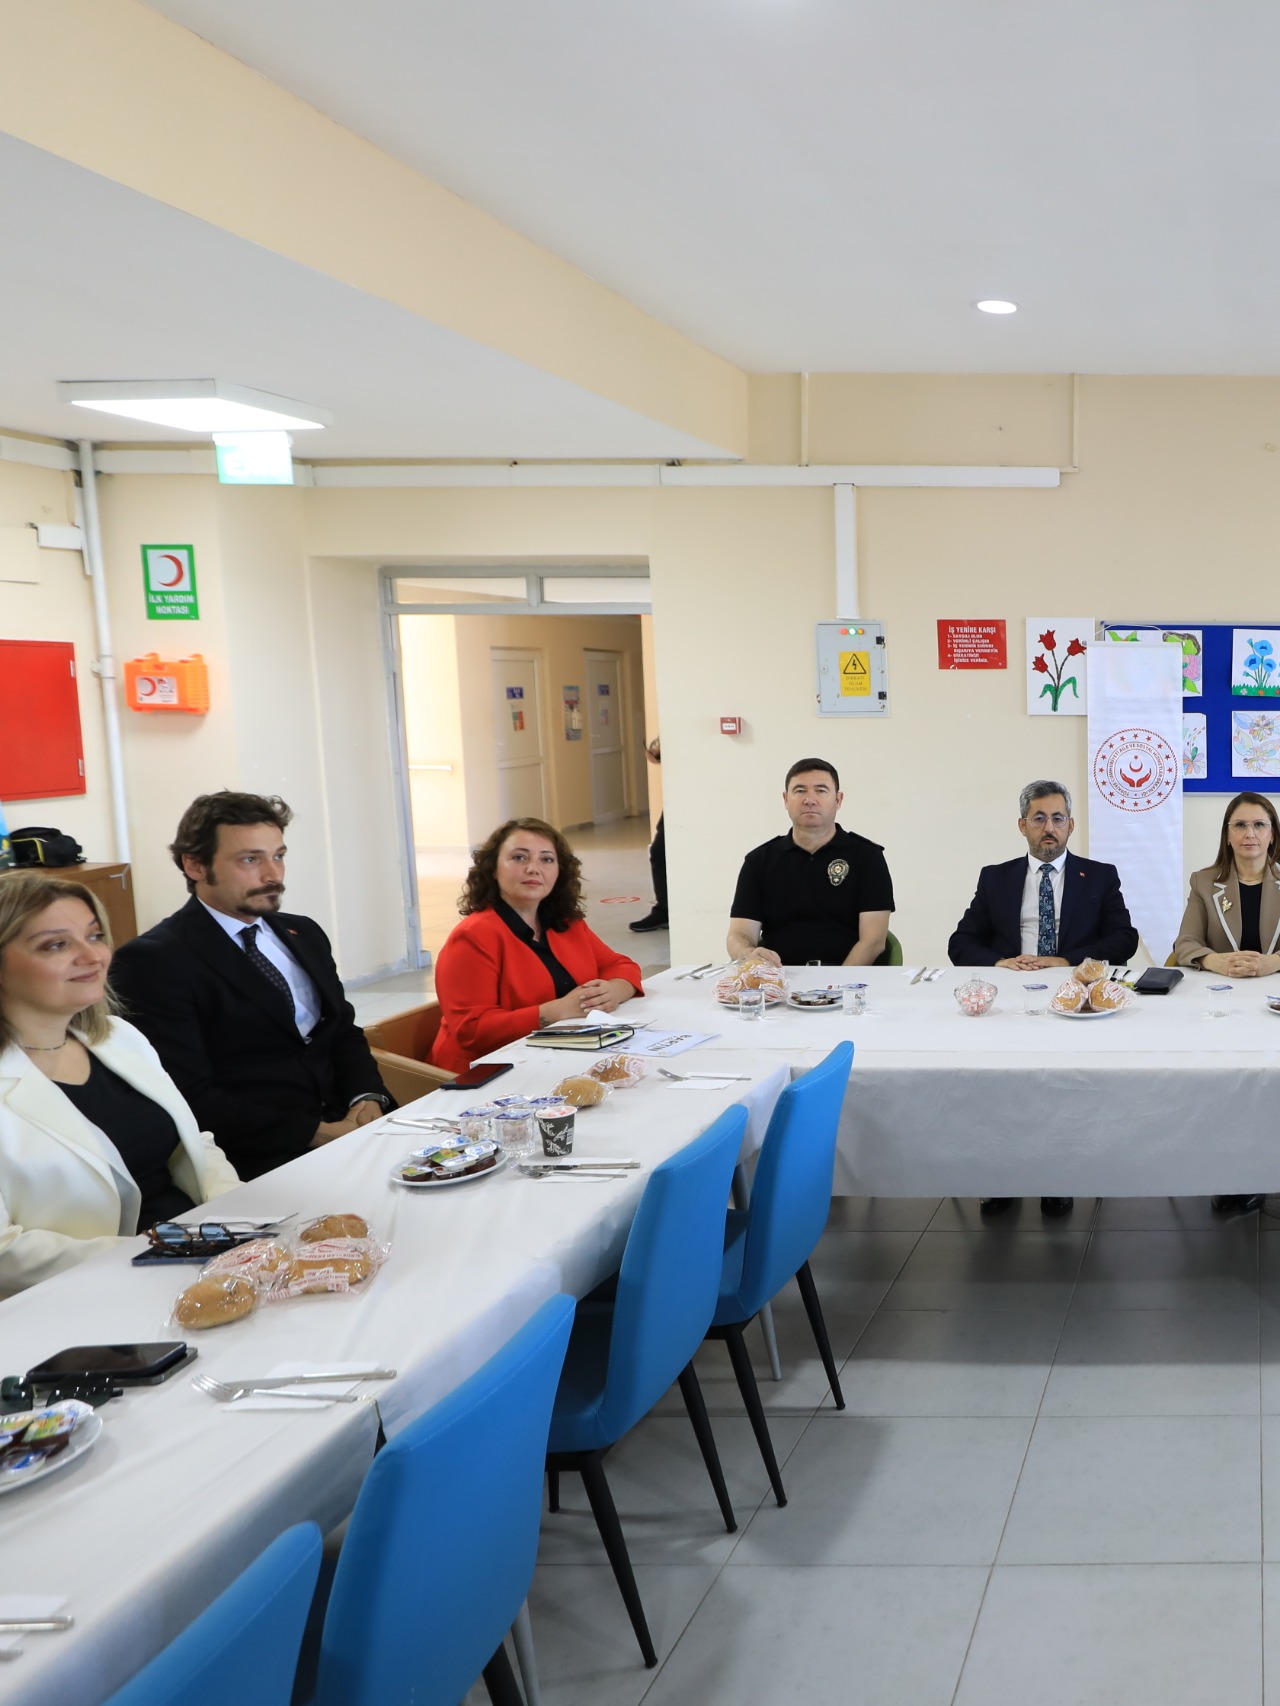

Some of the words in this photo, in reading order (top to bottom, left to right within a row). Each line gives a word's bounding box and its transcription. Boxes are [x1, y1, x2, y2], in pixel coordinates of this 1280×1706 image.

[149, 593, 162, 603] İLK
[164, 594, 194, 604] YARDIM
[156, 606, 189, 614] NOKTASI
[949, 625, 954, 634] İŞ
